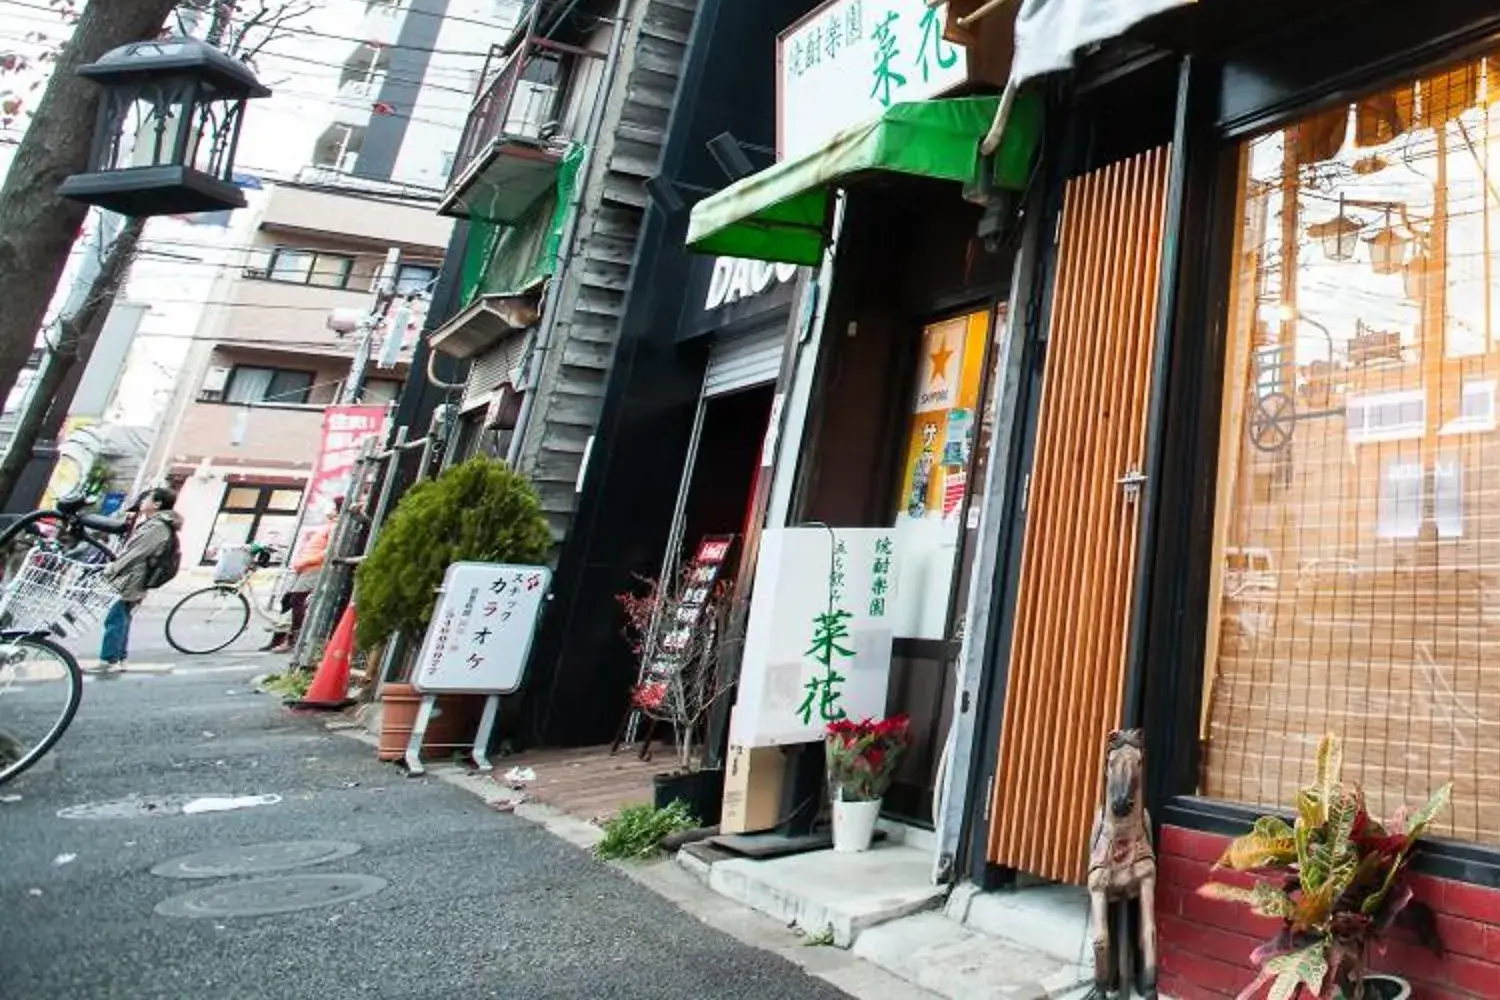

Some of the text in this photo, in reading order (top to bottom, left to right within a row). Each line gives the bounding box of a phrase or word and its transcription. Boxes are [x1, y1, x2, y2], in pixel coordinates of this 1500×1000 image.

[466, 577, 507, 670] カラオケ
[795, 609, 857, 726] 菜花
